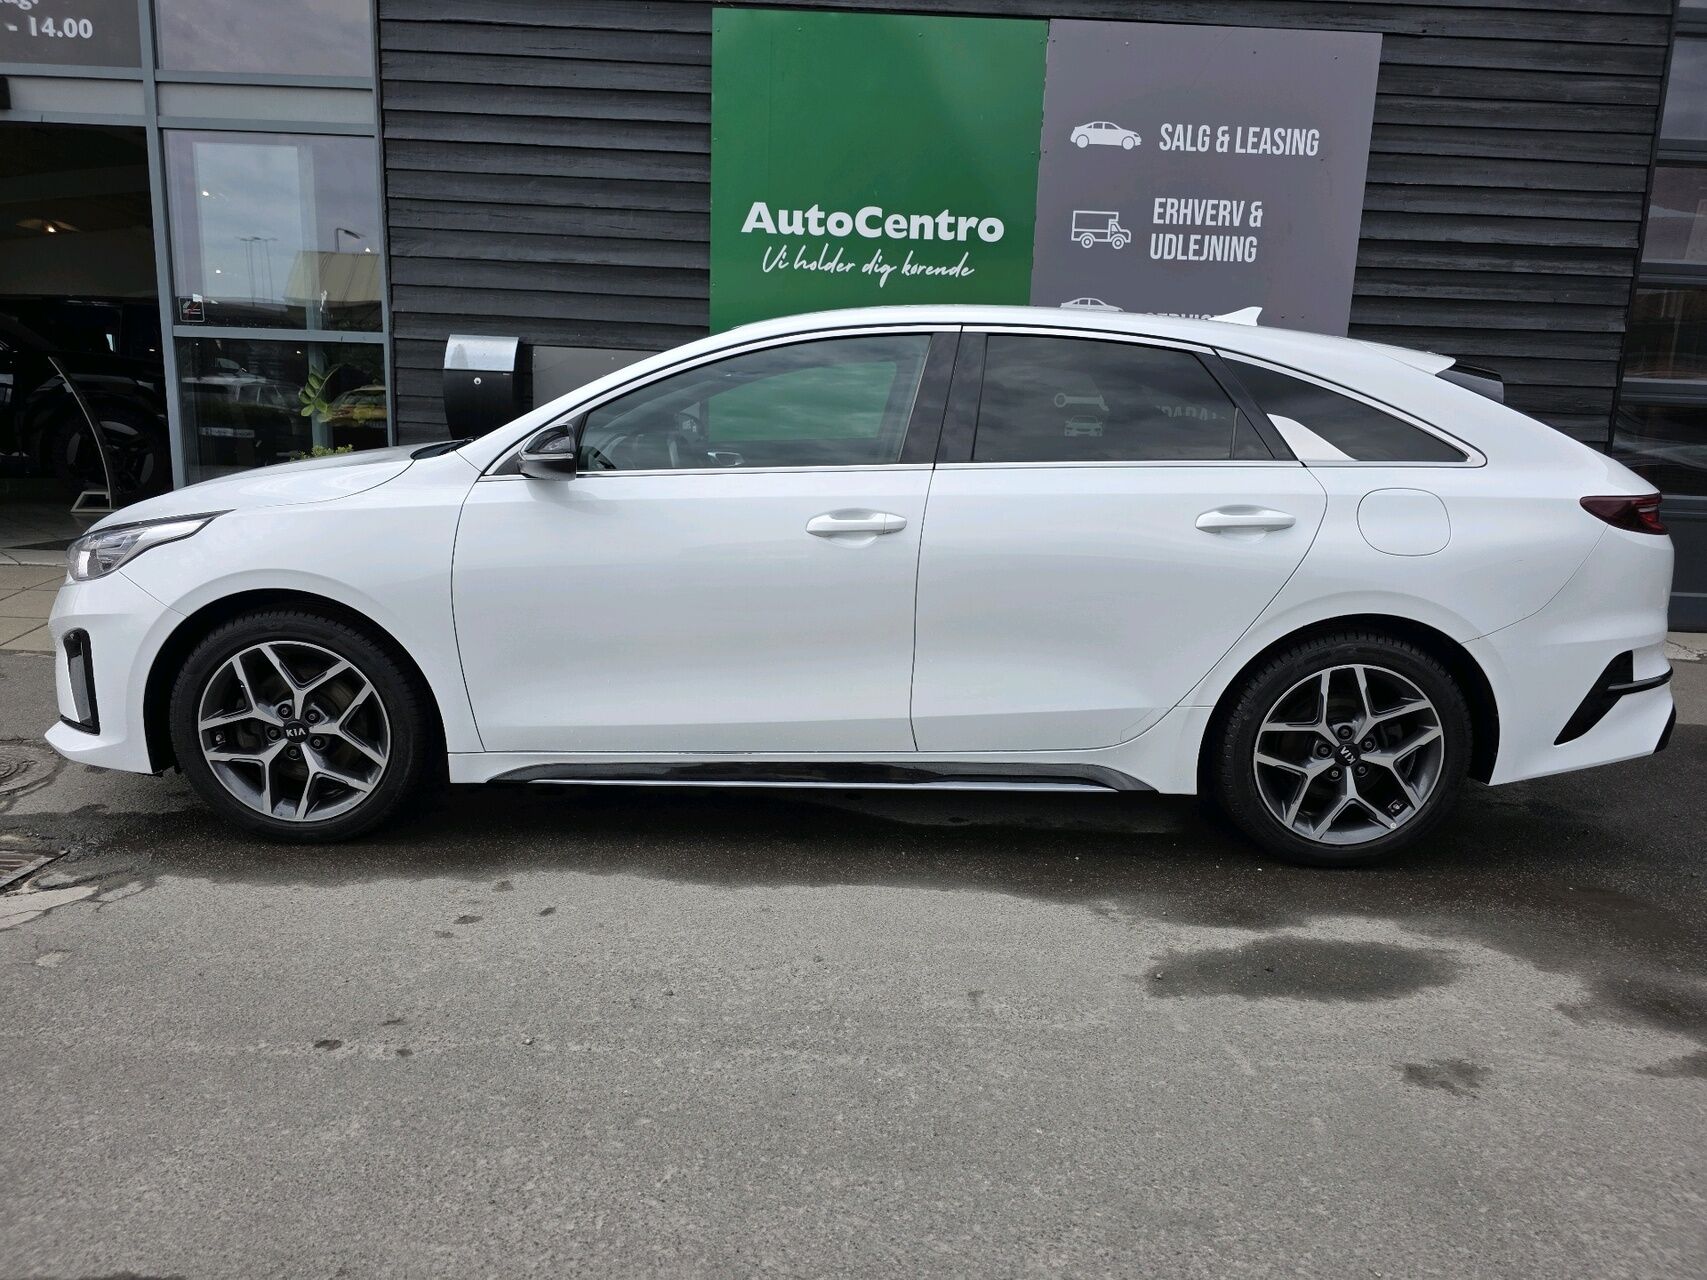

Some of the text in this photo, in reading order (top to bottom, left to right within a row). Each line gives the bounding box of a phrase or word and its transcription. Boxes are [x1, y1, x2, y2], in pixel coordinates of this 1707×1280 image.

[29, 17, 93, 38] 14.00
[1159, 123, 1320, 156] SALG & LEASING
[741, 201, 1004, 243] AutoCentro
[1152, 197, 1263, 228] ERHVERV &
[1150, 233, 1258, 263] UDLEJNING
[762, 244, 790, 273] Vi
[793, 243, 856, 274] holder
[861, 248, 897, 288] dig
[286, 728, 306, 737] KIA
